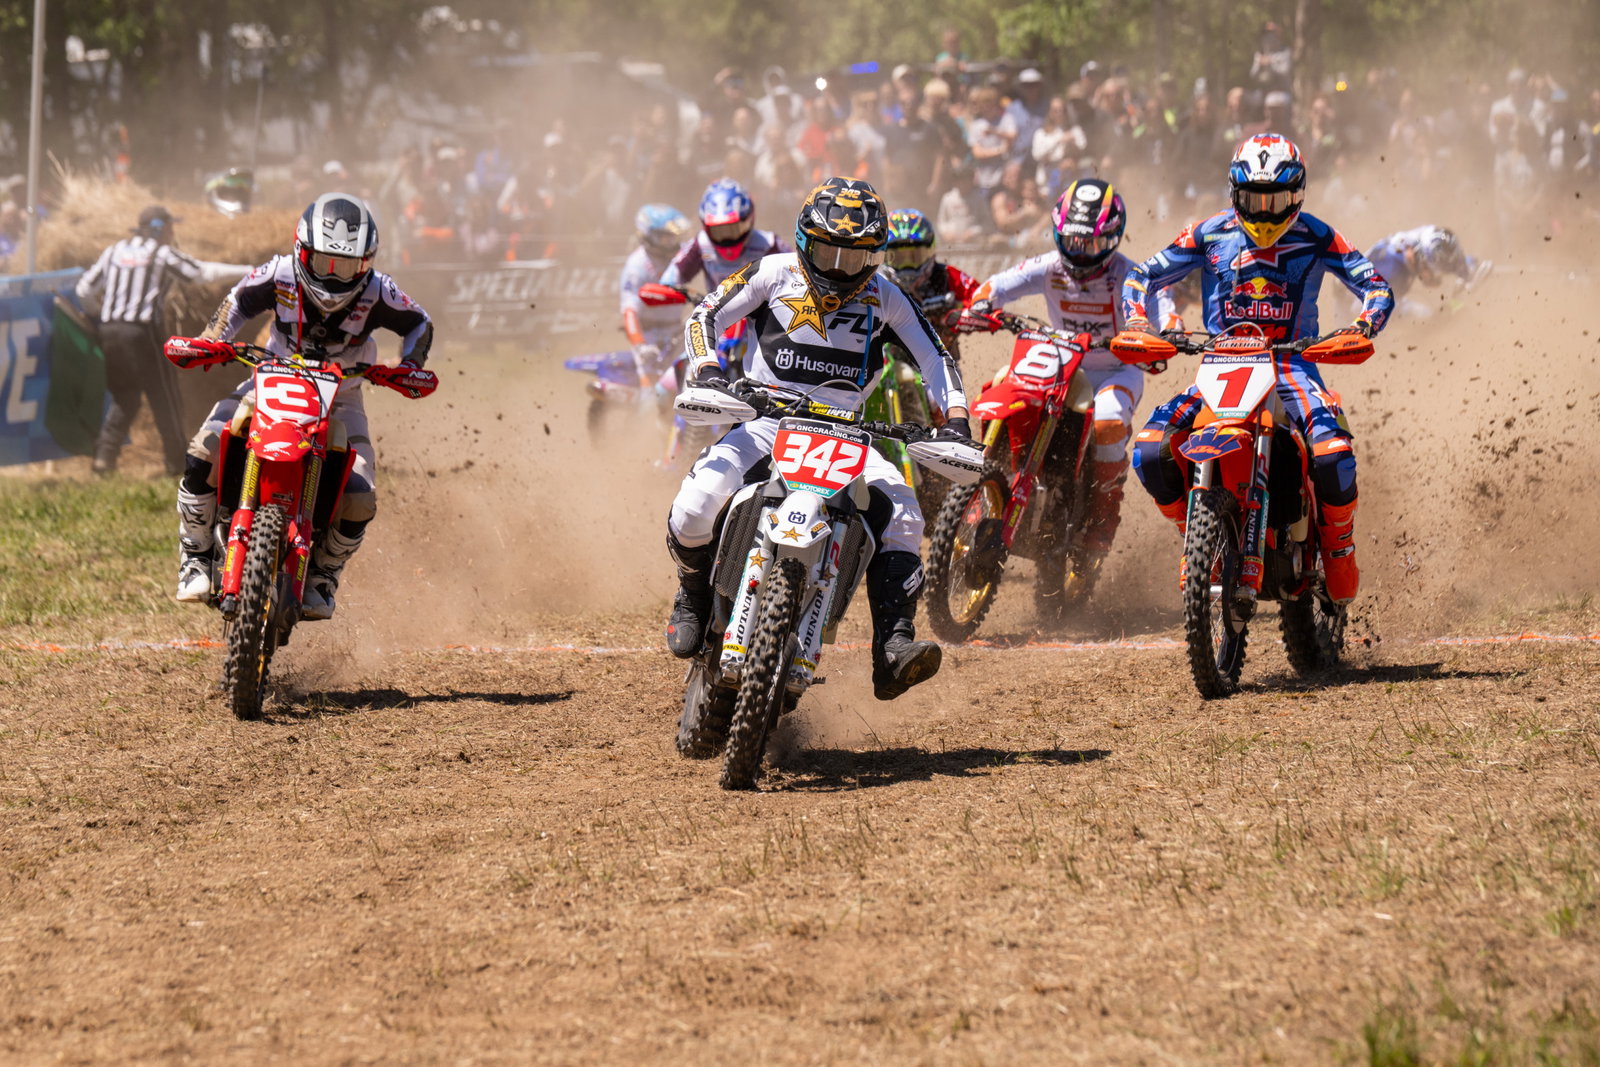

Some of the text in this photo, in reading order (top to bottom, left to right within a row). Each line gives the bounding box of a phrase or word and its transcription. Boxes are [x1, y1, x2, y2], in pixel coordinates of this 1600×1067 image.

[839, 187, 861, 199] 342
[1225, 300, 1293, 320] Red Bull
[1014, 343, 1073, 379] 8
[264, 376, 322, 418] 3
[1216, 367, 1254, 408] 1
[677, 402, 722, 415] ACERBIS
[777, 433, 863, 485] 342
[939, 458, 983, 473] ACERBIS
[799, 483, 831, 496] MOTOREX
[737, 589, 753, 645] UNLOP
[804, 590, 825, 650] DUNLOP
